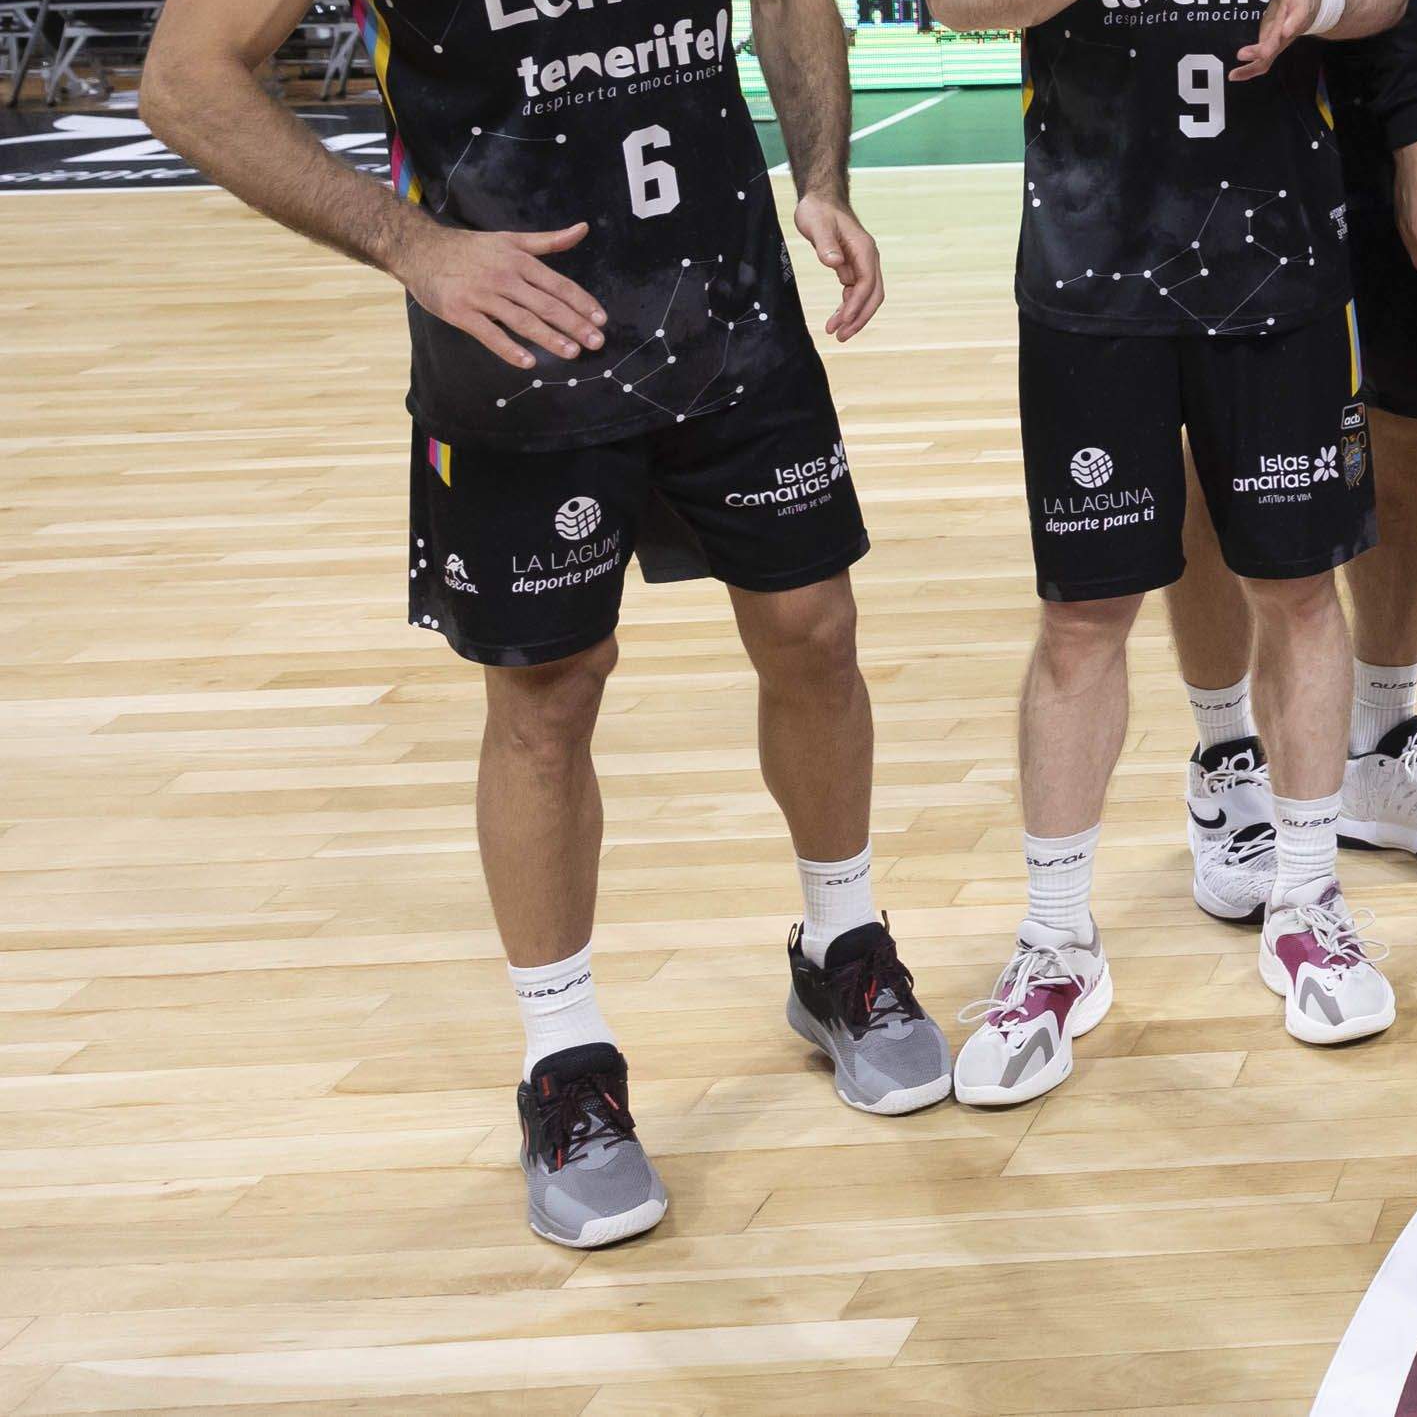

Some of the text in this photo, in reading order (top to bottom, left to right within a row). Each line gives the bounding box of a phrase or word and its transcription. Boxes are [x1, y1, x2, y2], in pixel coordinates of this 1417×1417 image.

[1103, 7, 1266, 28] despierta emocion
[517, 8, 728, 97] tenerife!
[522, 65, 717, 117] despierta emociones
[1178, 54, 1226, 138] 9
[622, 124, 680, 220] 6
[1344, 413, 1361, 426] acb
[775, 458, 827, 486] Islas
[1260, 454, 1309, 474] Islas
[724, 472, 830, 509] Canarias
[1233, 471, 1311, 492] anarias
[1044, 487, 1154, 514] LA LAGUNA
[1045, 505, 1154, 535] deporte para ti
[511, 561, 613, 594] deporte para
[513, 554, 543, 575] LA
